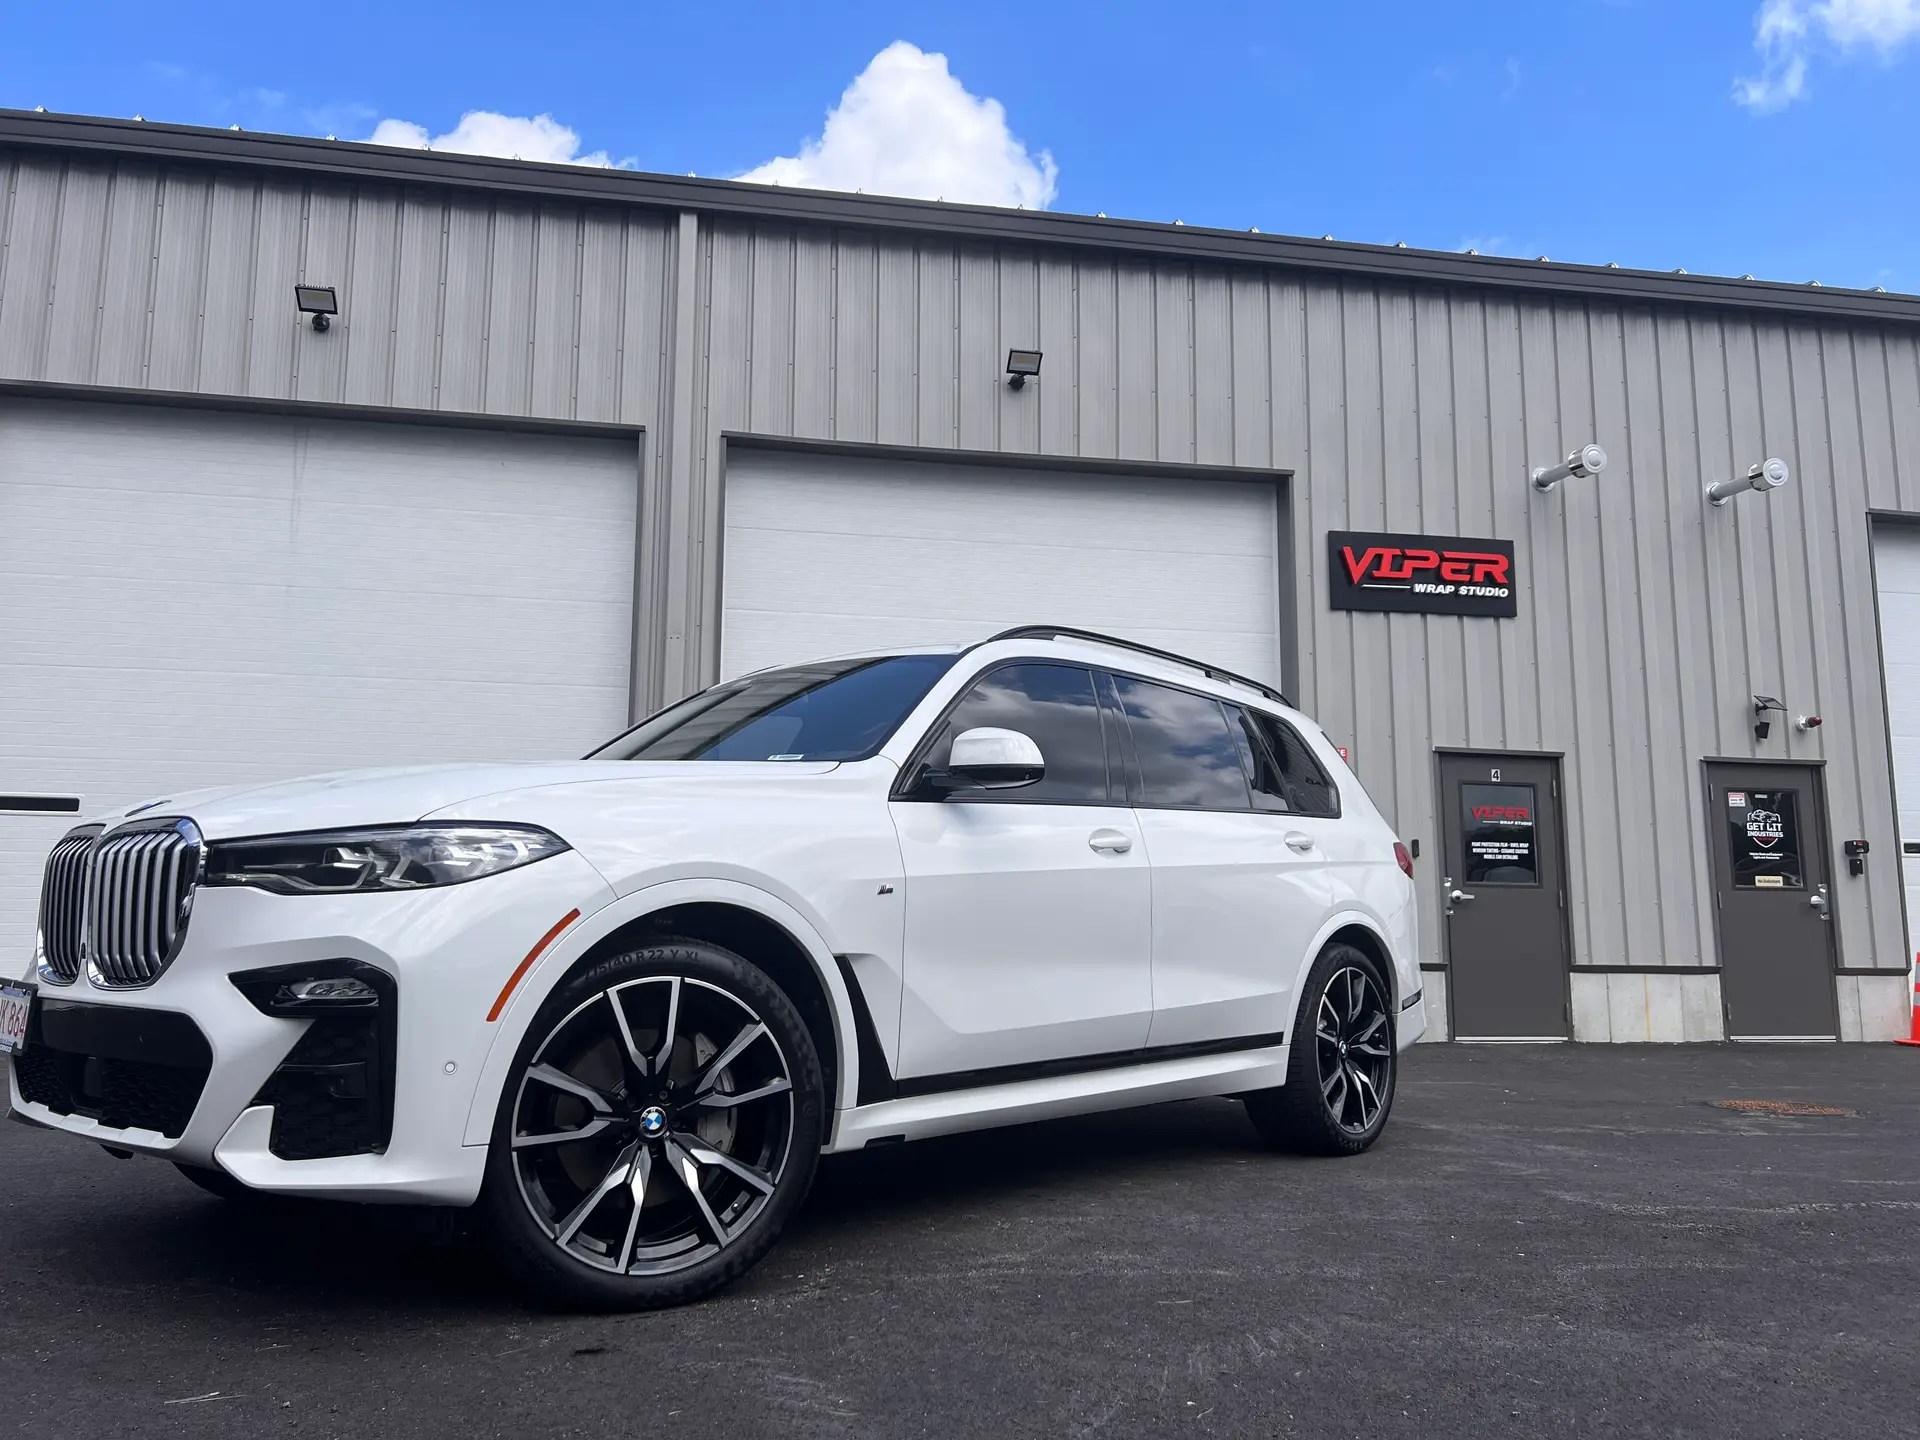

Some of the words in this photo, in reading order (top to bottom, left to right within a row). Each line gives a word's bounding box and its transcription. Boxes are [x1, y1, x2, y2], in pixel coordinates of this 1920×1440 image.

[1342, 546, 1509, 584] VIPER
[1413, 583, 1455, 594] WRAP
[1458, 585, 1509, 598] STUDIO
[1493, 770, 1499, 781] 4
[1471, 806, 1529, 820] VIPER
[1746, 822, 1764, 831] GET
[1766, 823, 1782, 831] LIT
[647, 948, 665, 960] 22
[8, 1002, 28, 1038] 864
